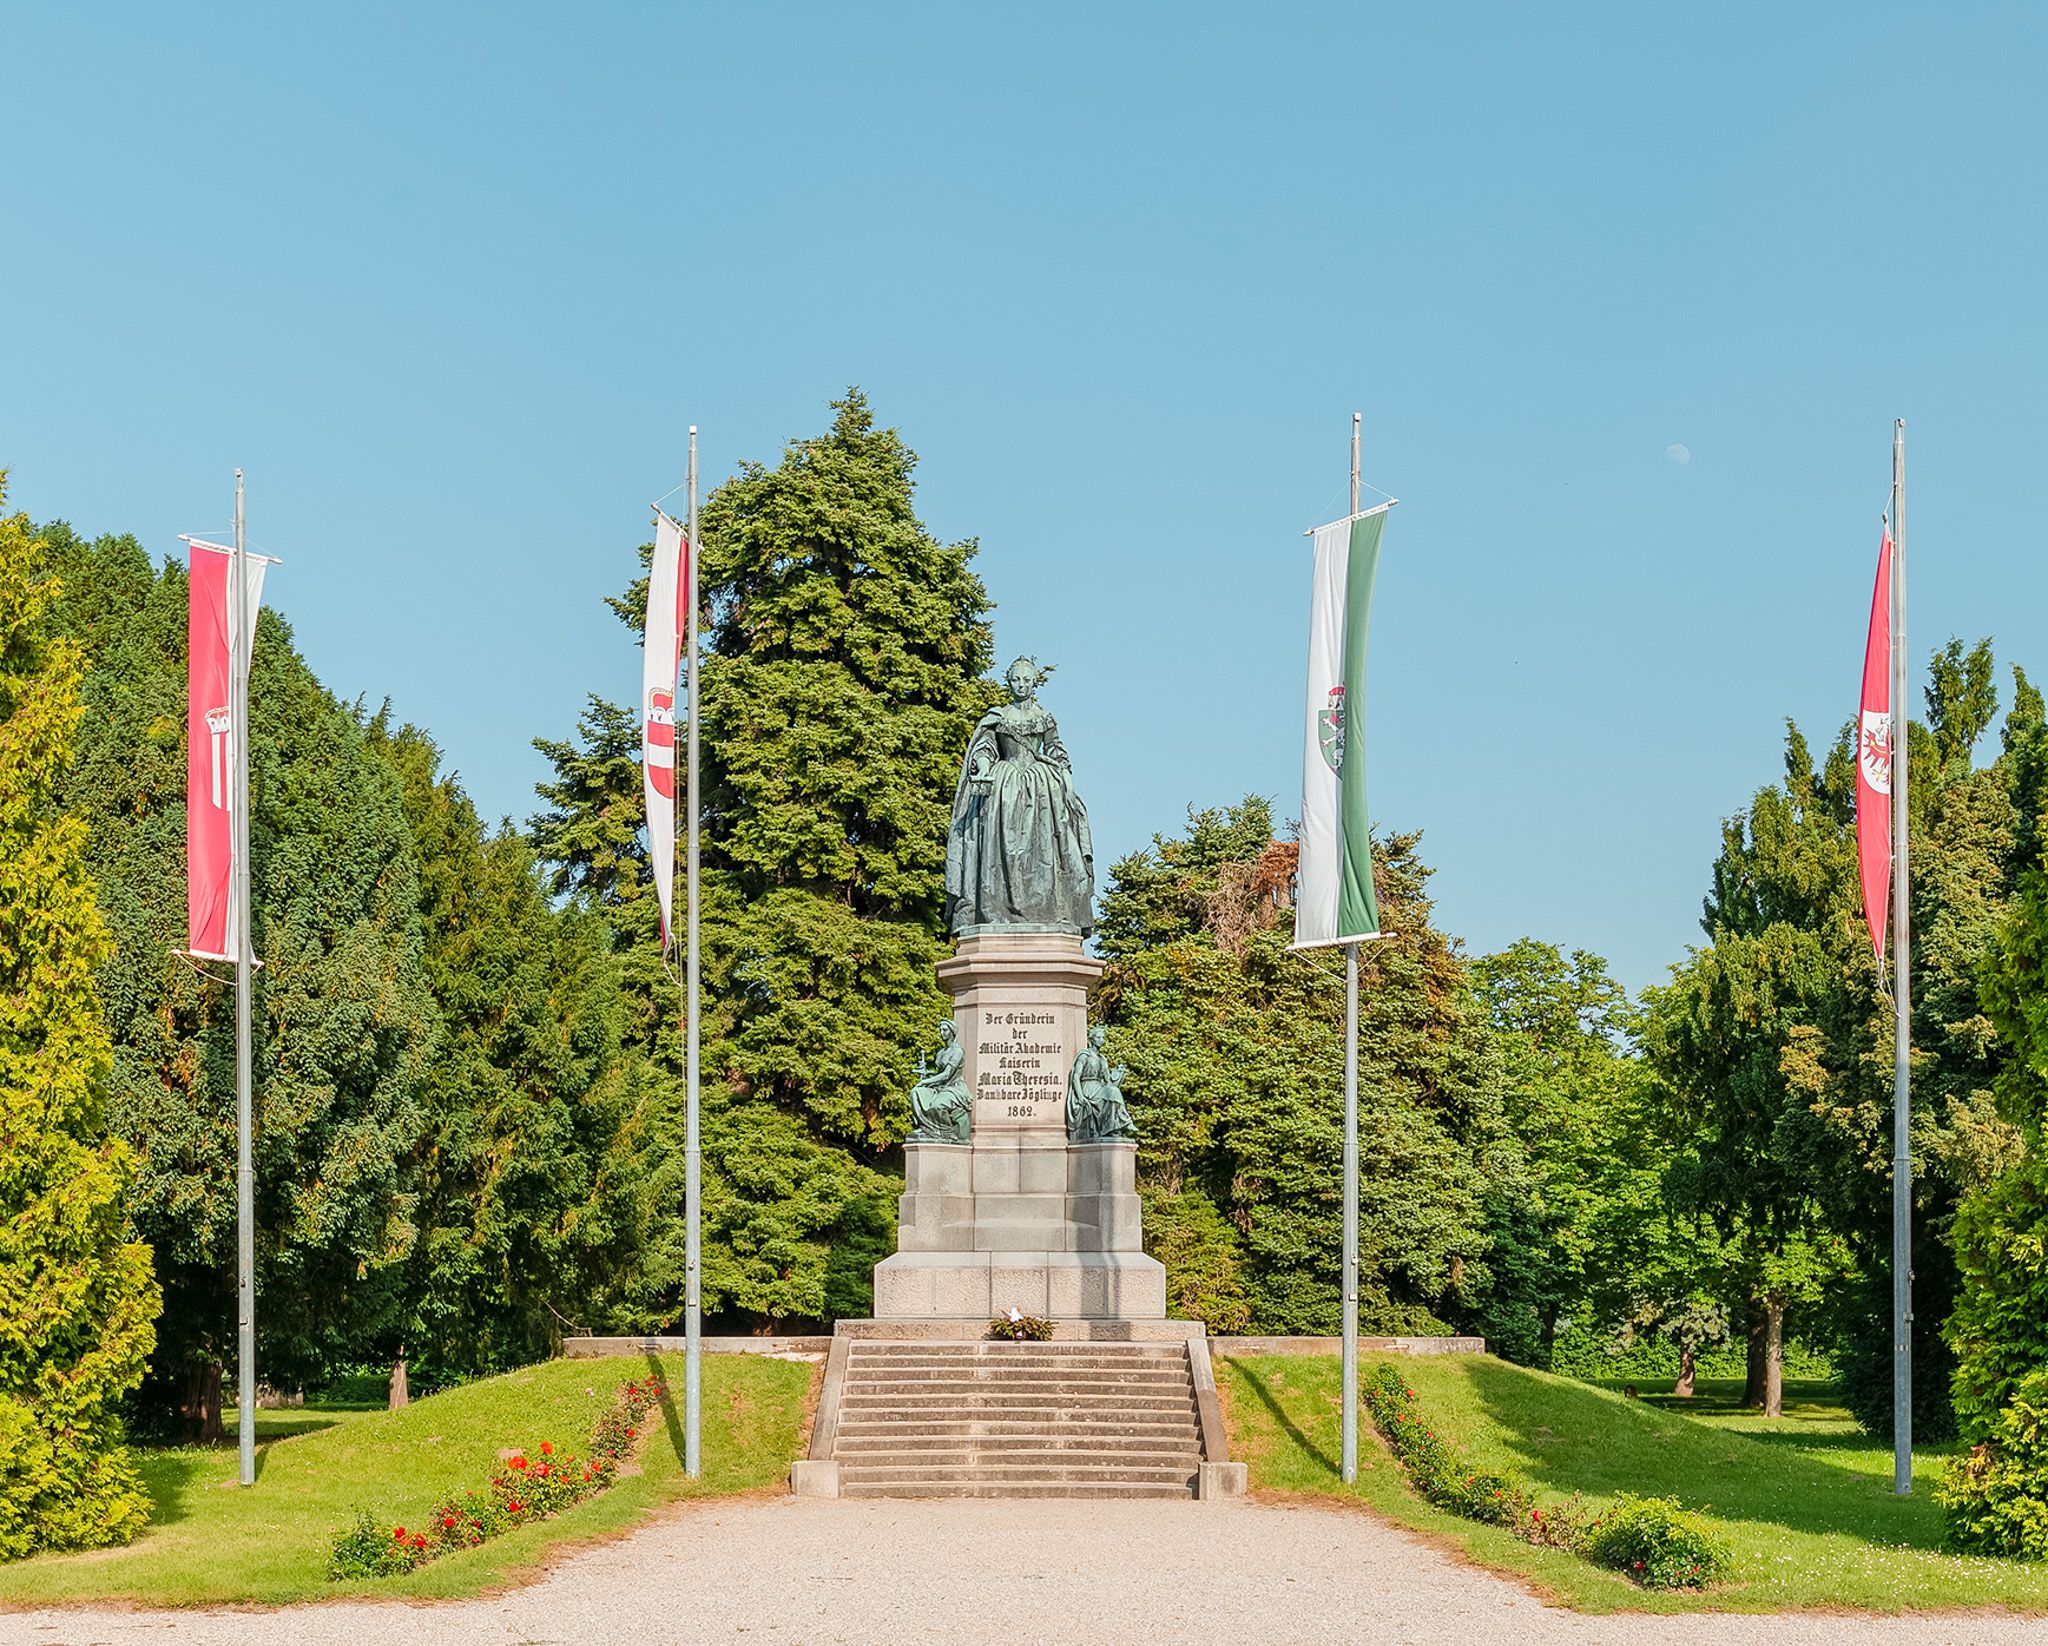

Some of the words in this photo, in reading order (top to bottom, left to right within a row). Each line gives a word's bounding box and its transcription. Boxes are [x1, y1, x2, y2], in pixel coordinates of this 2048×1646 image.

[985, 1012, 1003, 1024] Der
[1005, 1012, 1055, 1024] Gründerin
[1012, 1027, 1028, 1039] der
[979, 1042, 1014, 1054] Militär
[1015, 1042, 1061, 1054] Akademie
[999, 1057, 1040, 1068] Kaiserin
[977, 1072, 1012, 1086] Maria
[1012, 1070, 1062, 1087] Theresia.
[1007, 1105, 1036, 1117] 1862.
